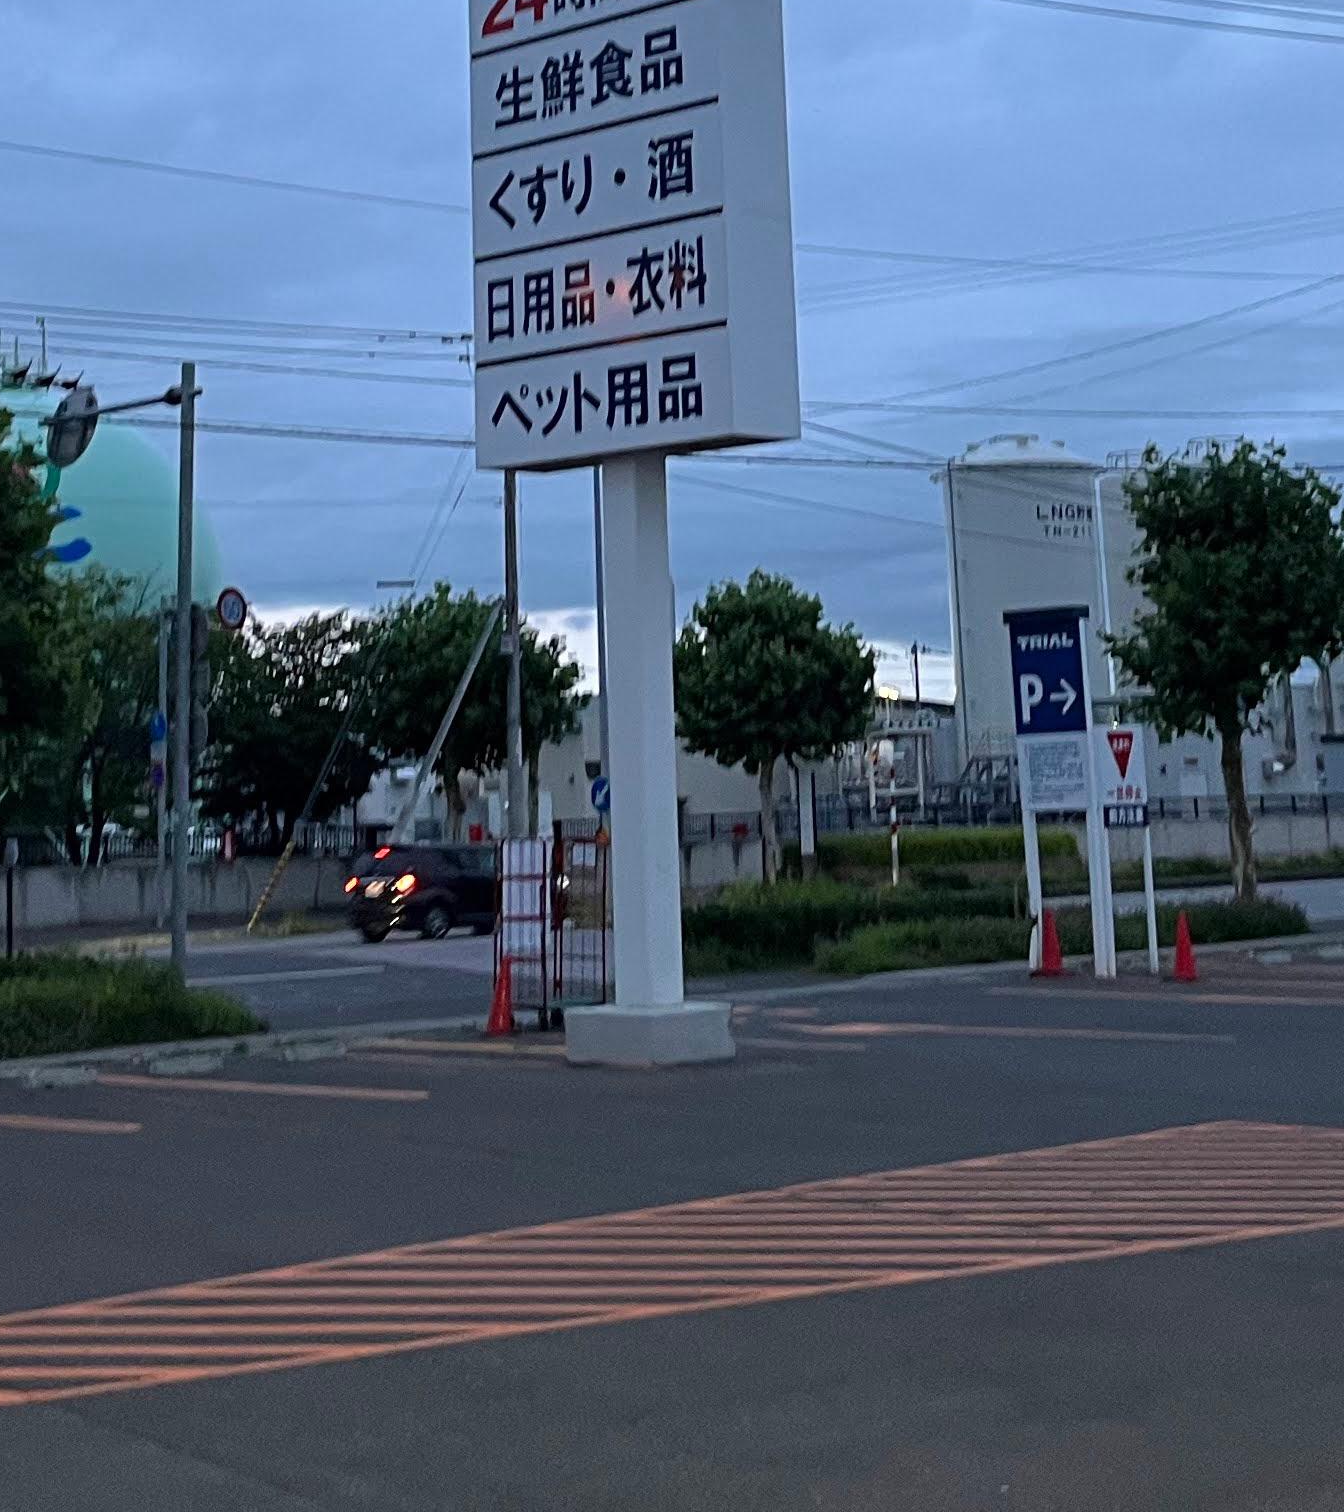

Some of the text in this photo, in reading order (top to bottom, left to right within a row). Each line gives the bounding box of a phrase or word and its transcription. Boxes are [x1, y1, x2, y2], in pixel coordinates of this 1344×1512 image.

[494, 25, 684, 131] 生鮮食品
[487, 235, 707, 343] 日用品・衣料
[491, 352, 704, 437] ペット用品
[1017, 632, 1074, 652] TRIAL
[1020, 673, 1043, 724] P
